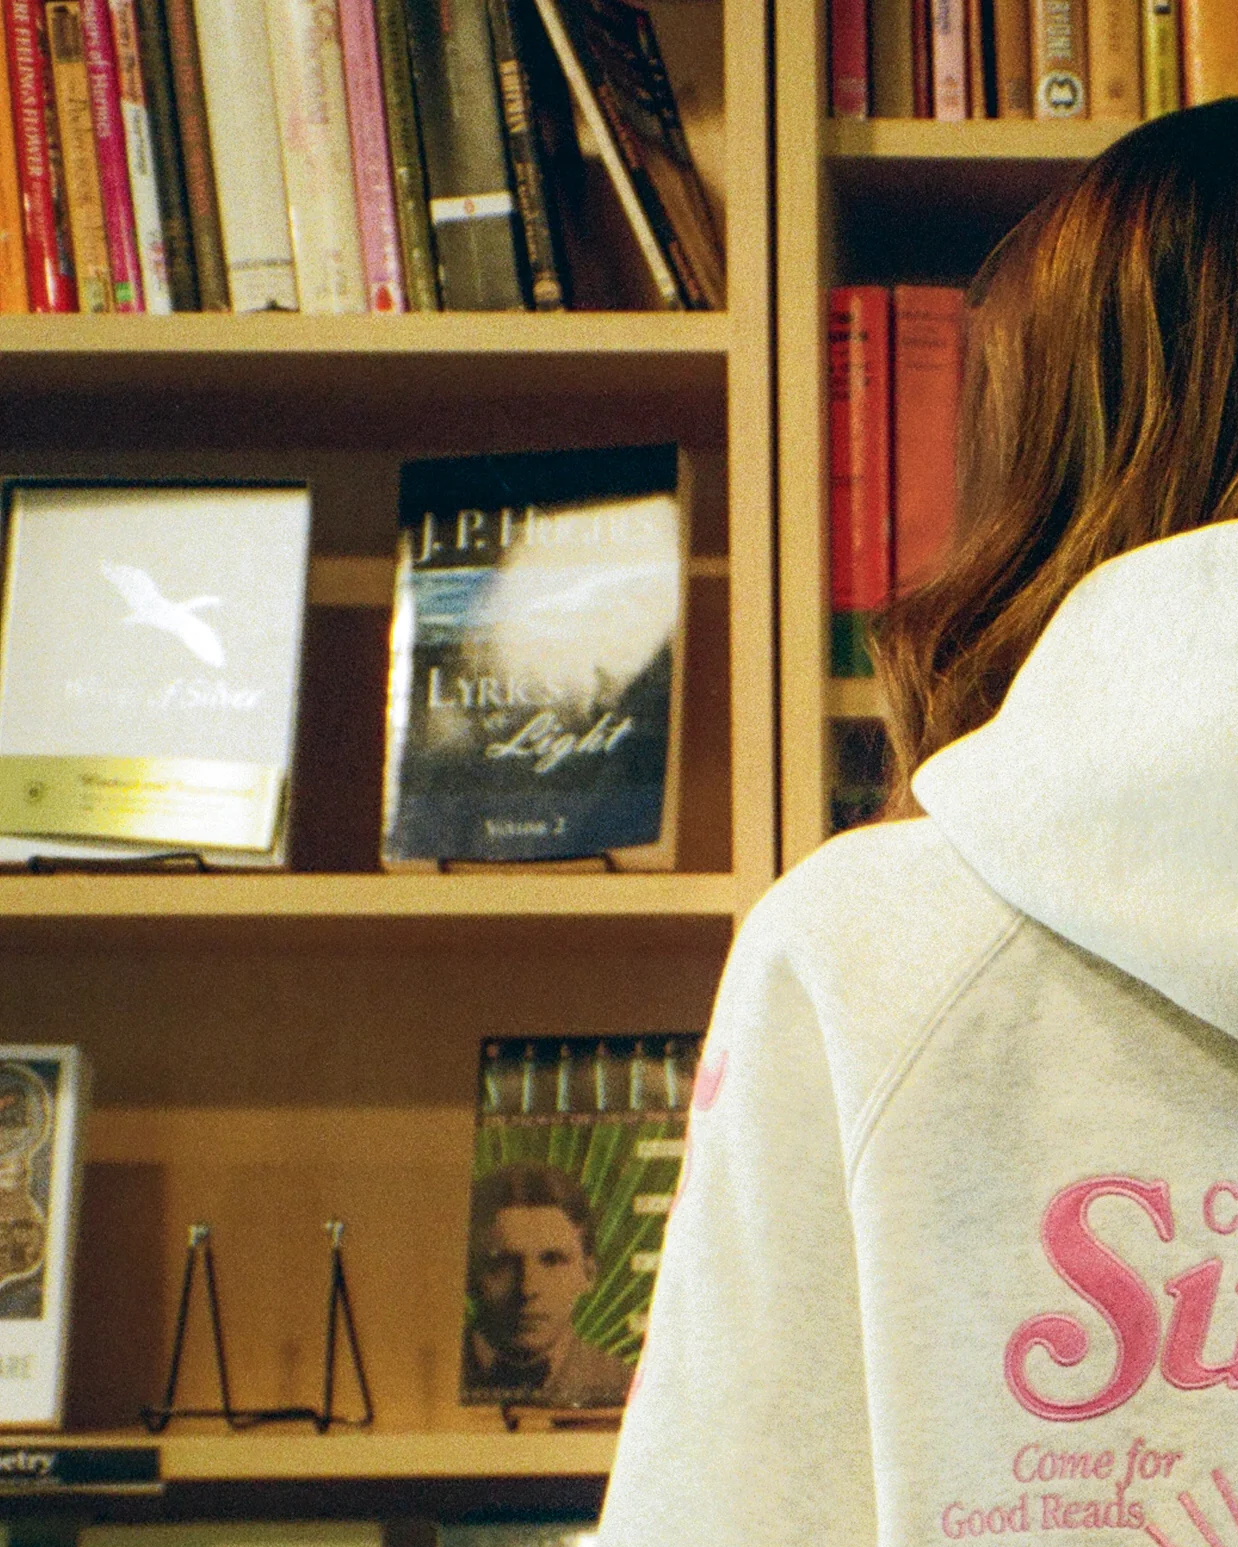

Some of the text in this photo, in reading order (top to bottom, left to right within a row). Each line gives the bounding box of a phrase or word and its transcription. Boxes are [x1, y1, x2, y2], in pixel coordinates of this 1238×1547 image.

[22, 107, 43, 178] FLOWER
[484, 710, 635, 774] Light
[0, 1449, 57, 1476] etry
[1012, 1435, 1184, 1490] Come for
[941, 1489, 1146, 1540] Good Reads
